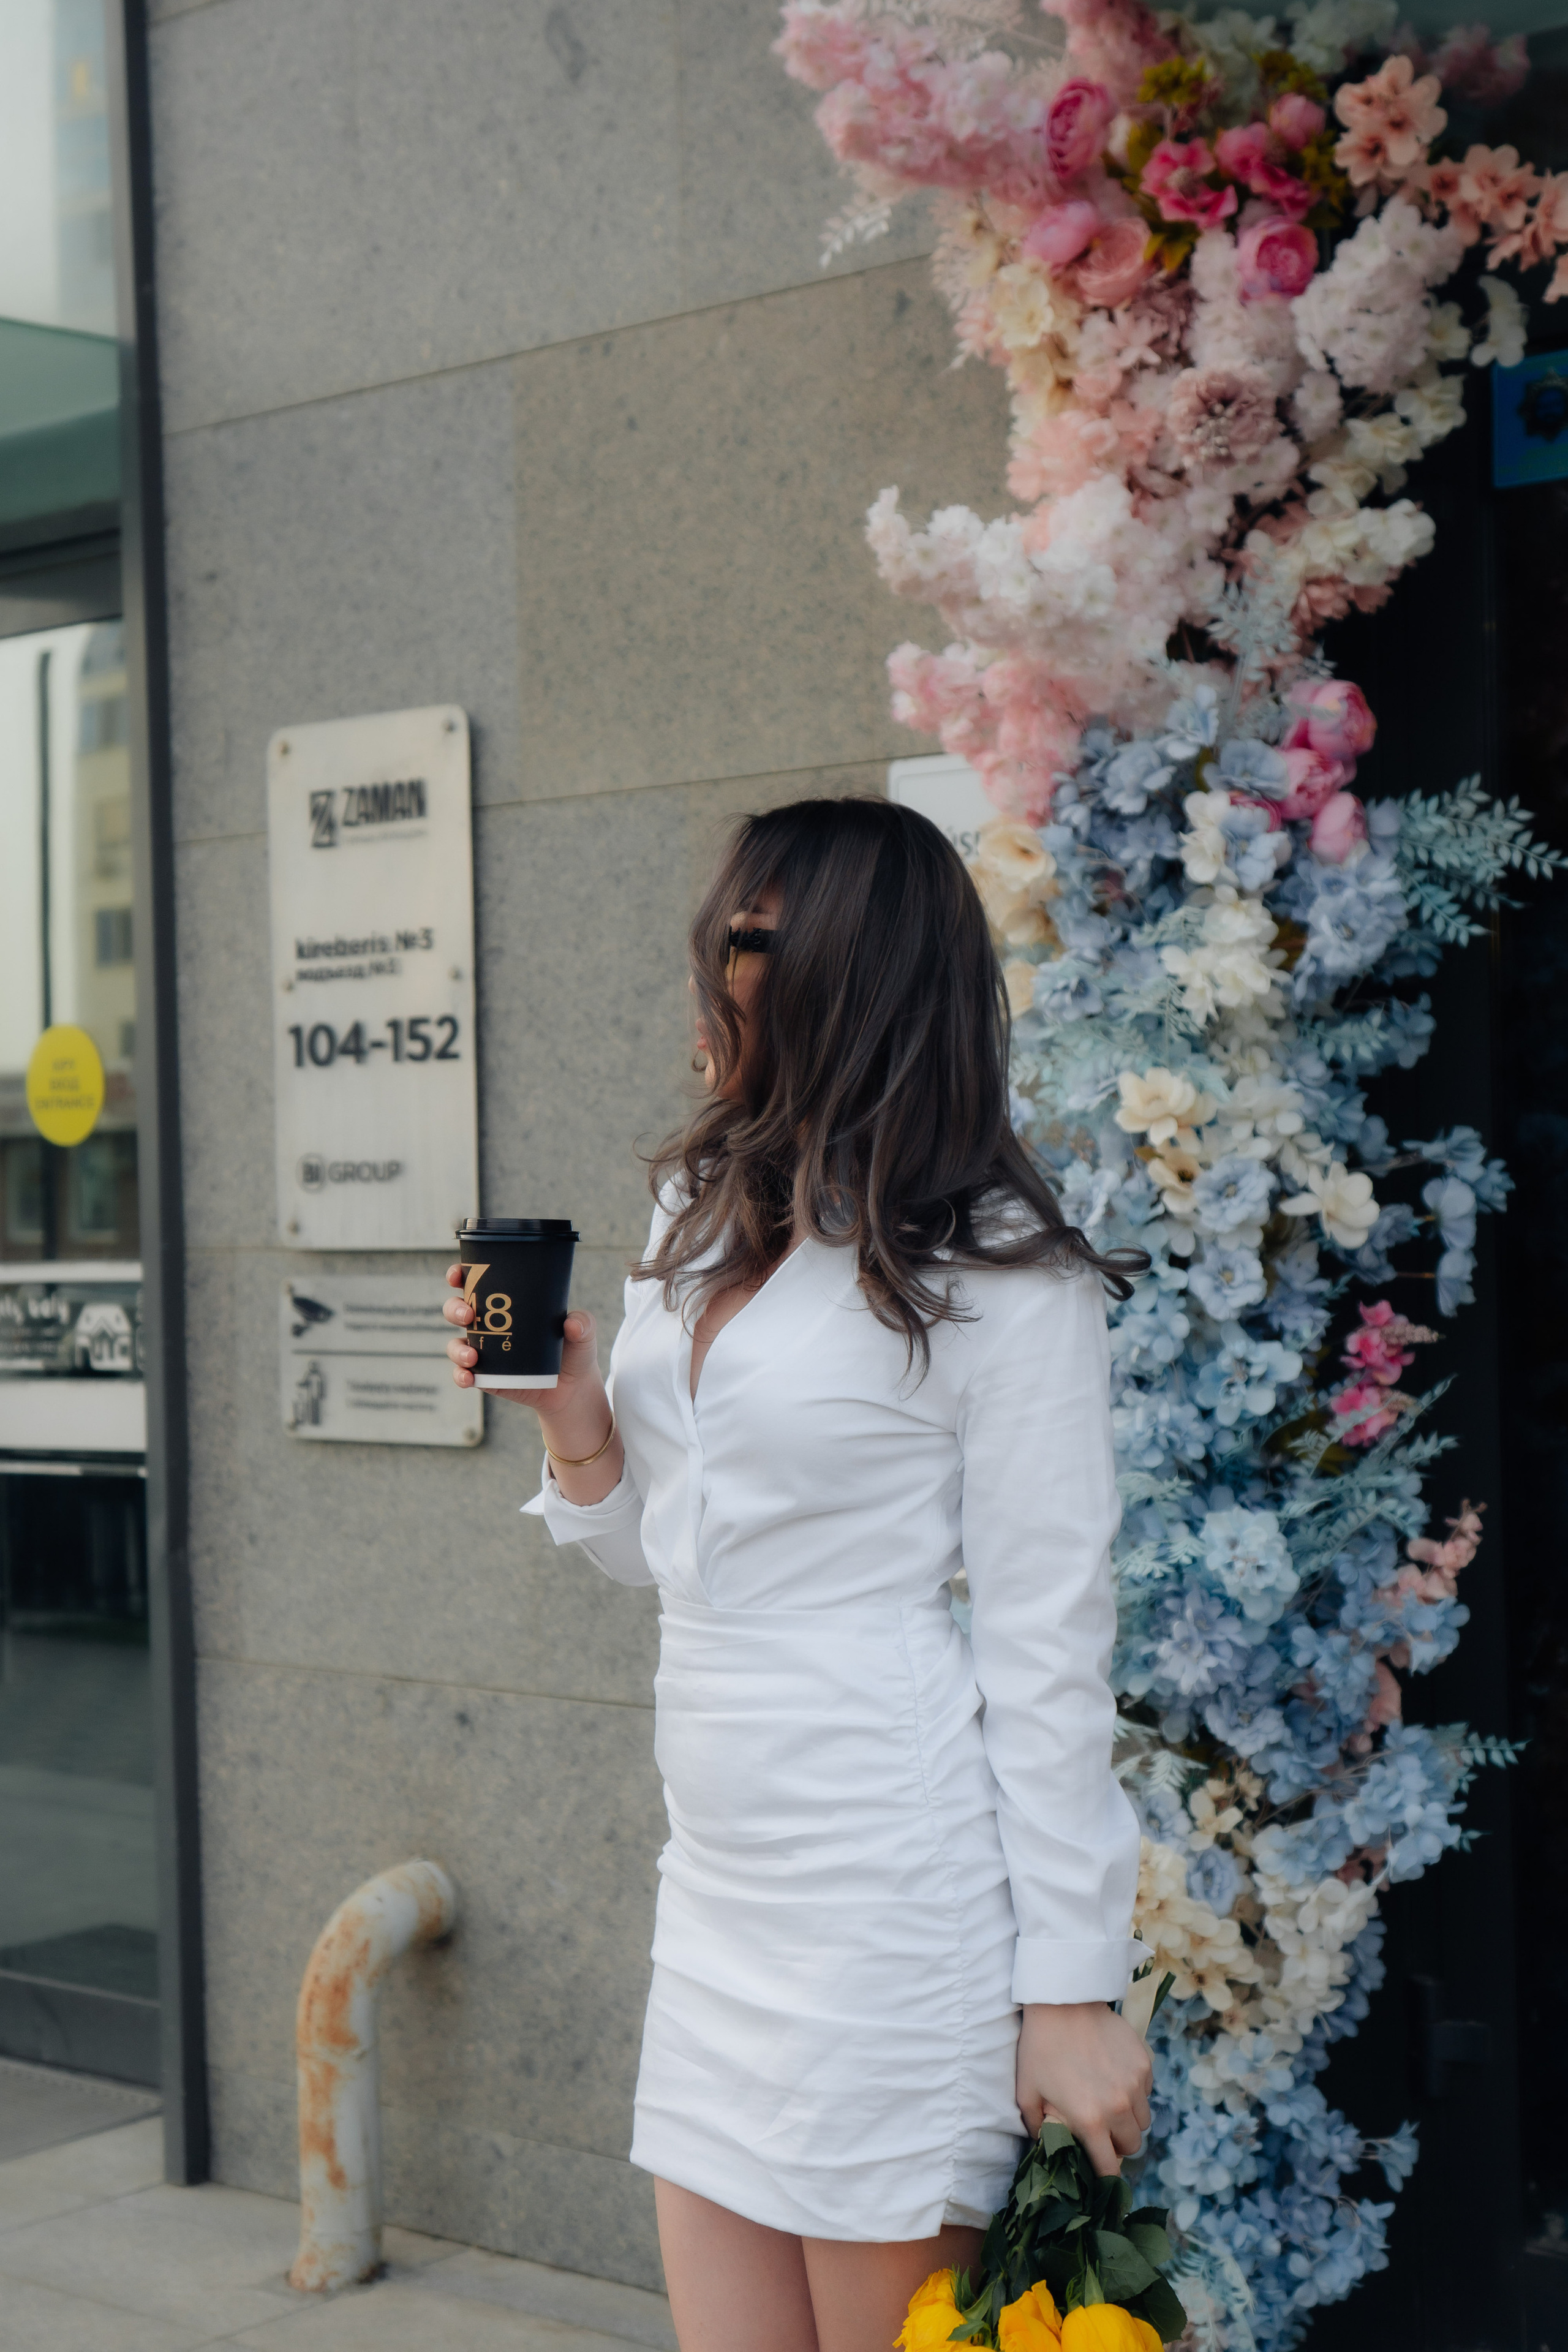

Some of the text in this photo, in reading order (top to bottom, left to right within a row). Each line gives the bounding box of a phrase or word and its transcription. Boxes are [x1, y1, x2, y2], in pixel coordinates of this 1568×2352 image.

[341, 776, 427, 827] ZAMAN
[288, 1014, 460, 1068] 104-152
[328, 1159, 405, 1185] GROUP
